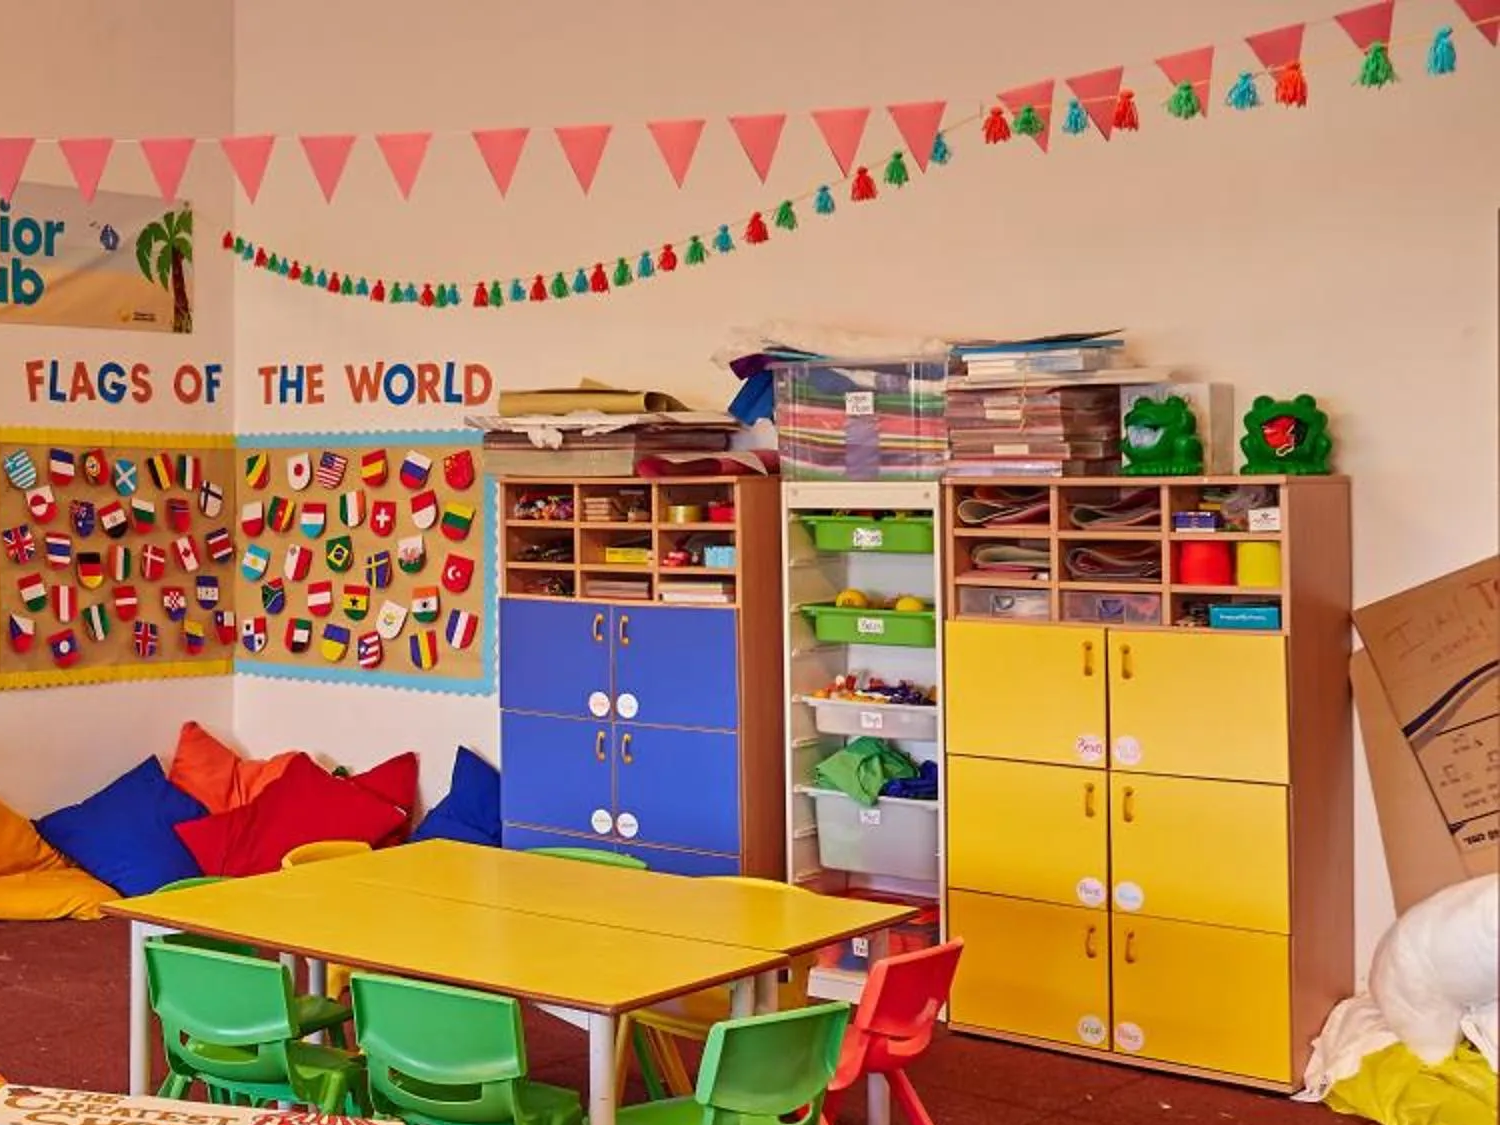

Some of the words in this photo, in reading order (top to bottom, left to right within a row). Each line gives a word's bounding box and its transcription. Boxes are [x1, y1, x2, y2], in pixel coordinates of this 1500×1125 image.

[25, 359, 153, 404] FLAGS
[173, 363, 222, 404] OF
[258, 363, 324, 405] THE
[345, 360, 492, 406] WORLD
